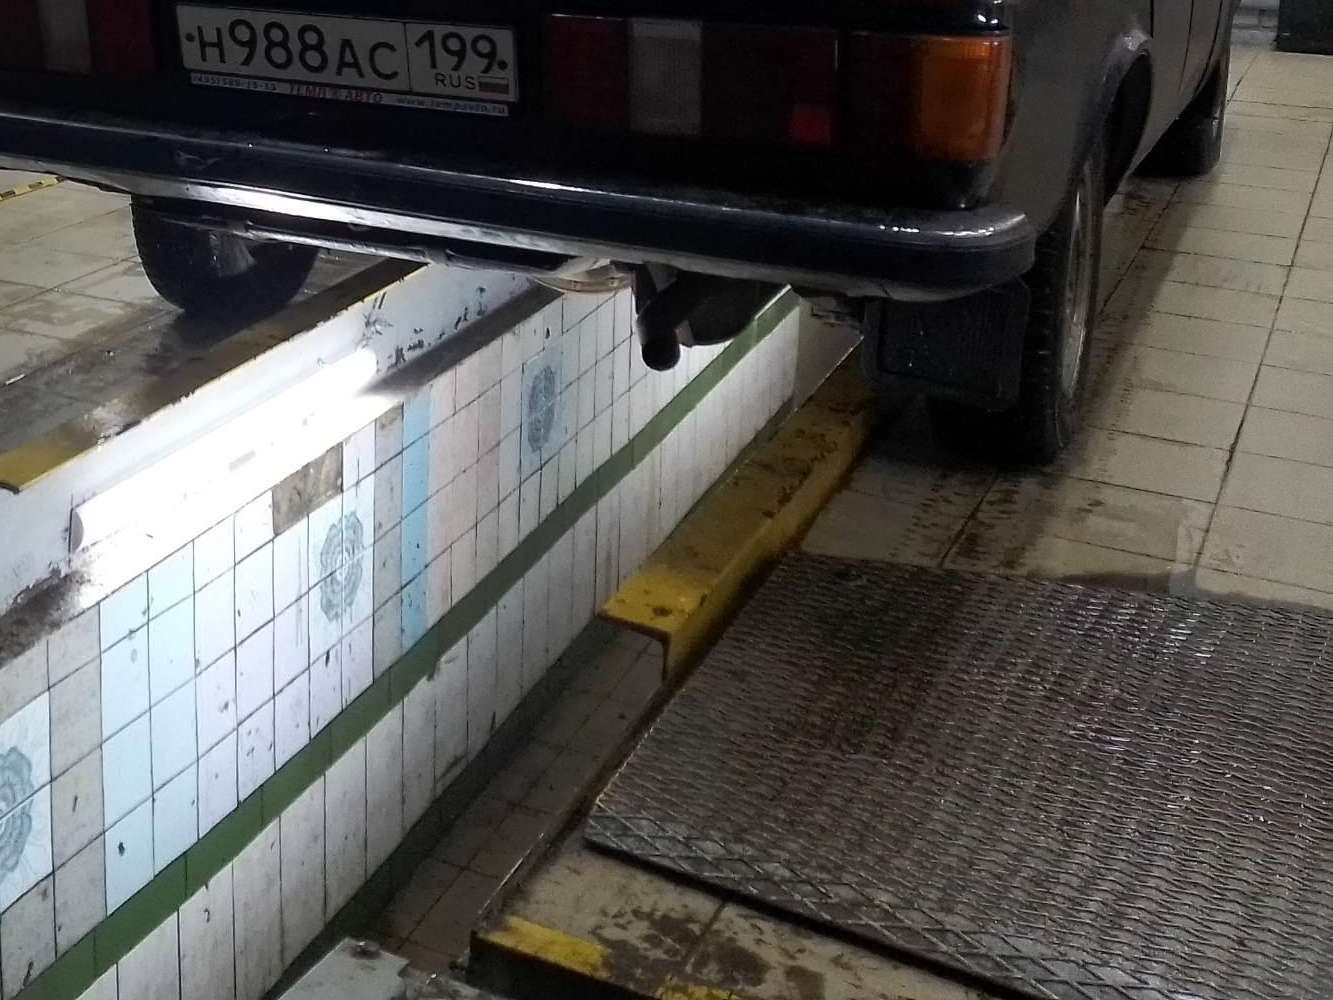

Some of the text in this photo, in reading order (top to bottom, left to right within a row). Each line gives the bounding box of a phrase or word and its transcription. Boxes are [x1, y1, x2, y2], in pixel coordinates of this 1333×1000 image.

[197, 18, 498, 81] Н988АС 199
[434, 73, 476, 91] RUS
